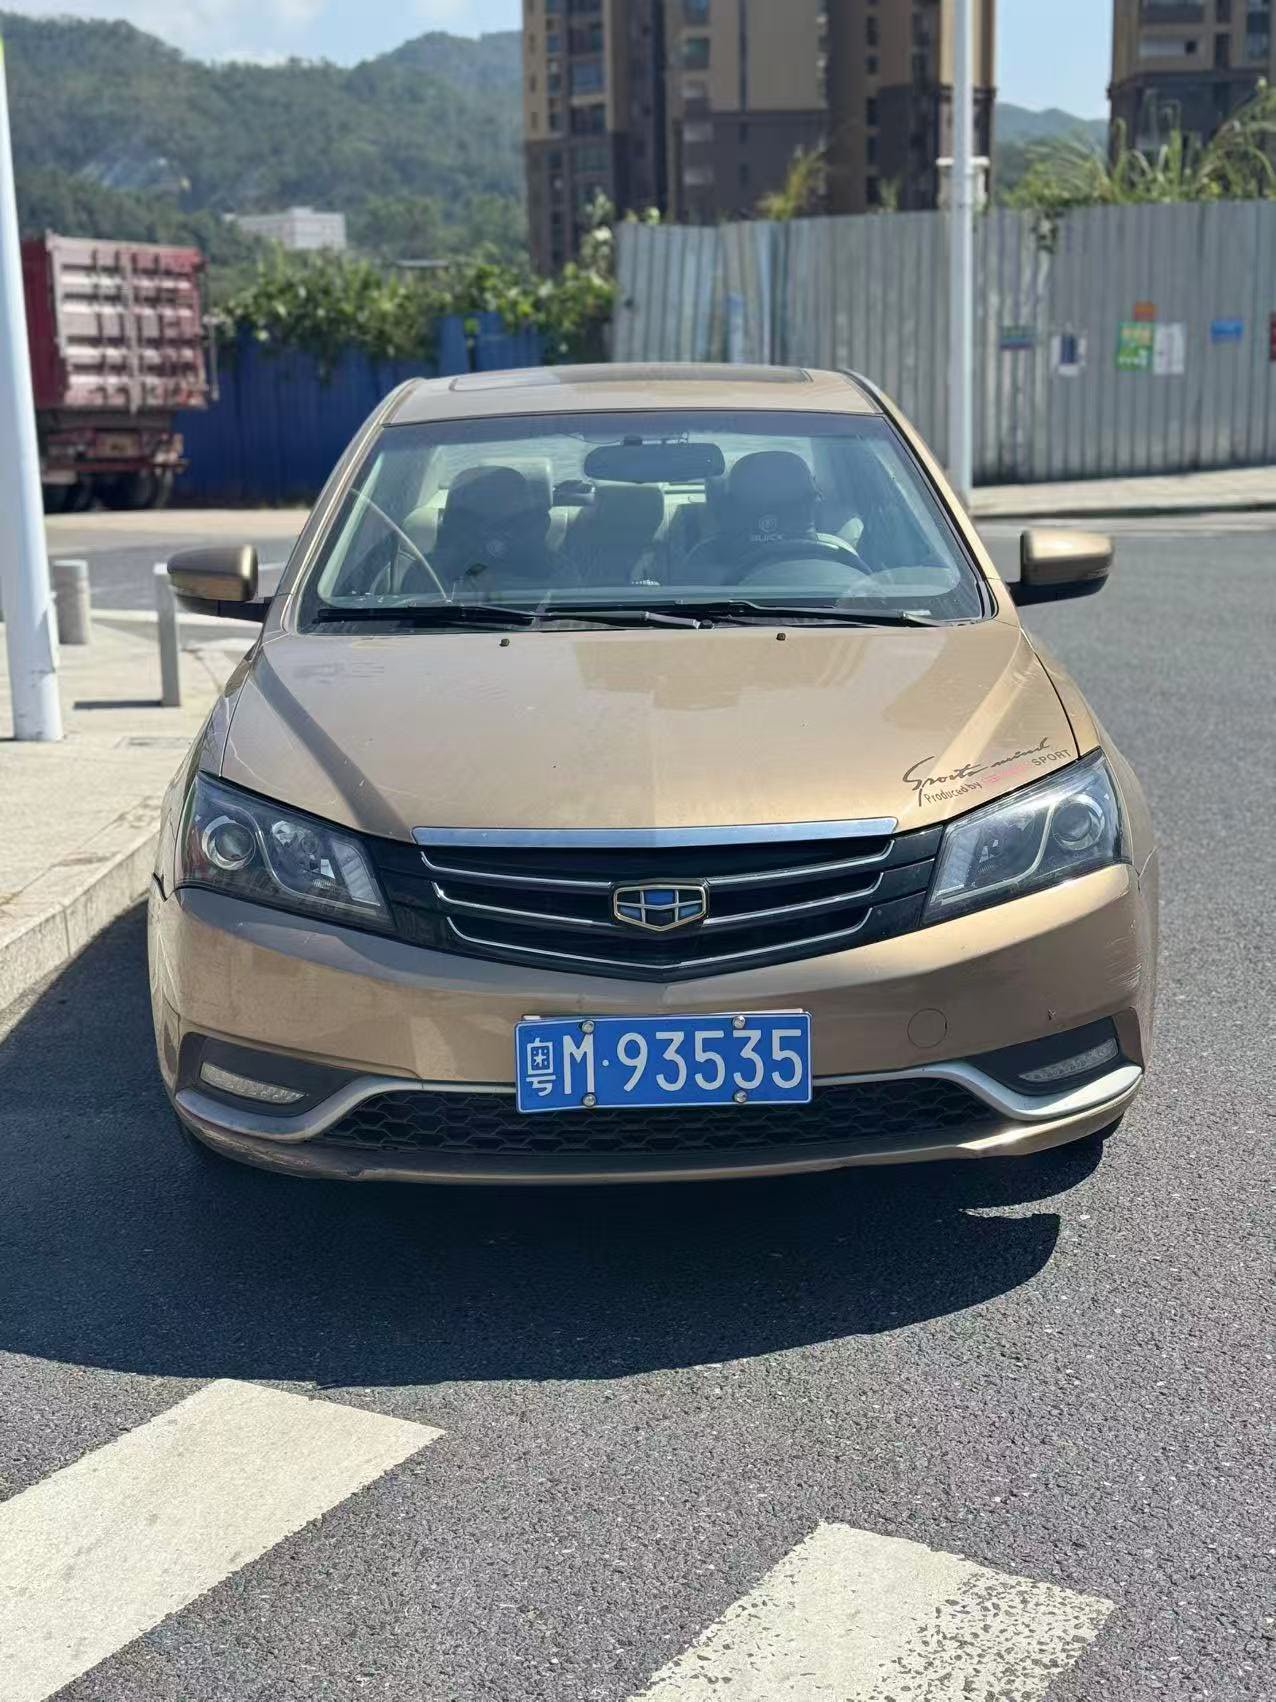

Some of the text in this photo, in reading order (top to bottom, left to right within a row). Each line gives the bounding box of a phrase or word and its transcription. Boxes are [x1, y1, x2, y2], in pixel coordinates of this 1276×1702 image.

[923, 749, 1073, 804] Produced by SPORT
